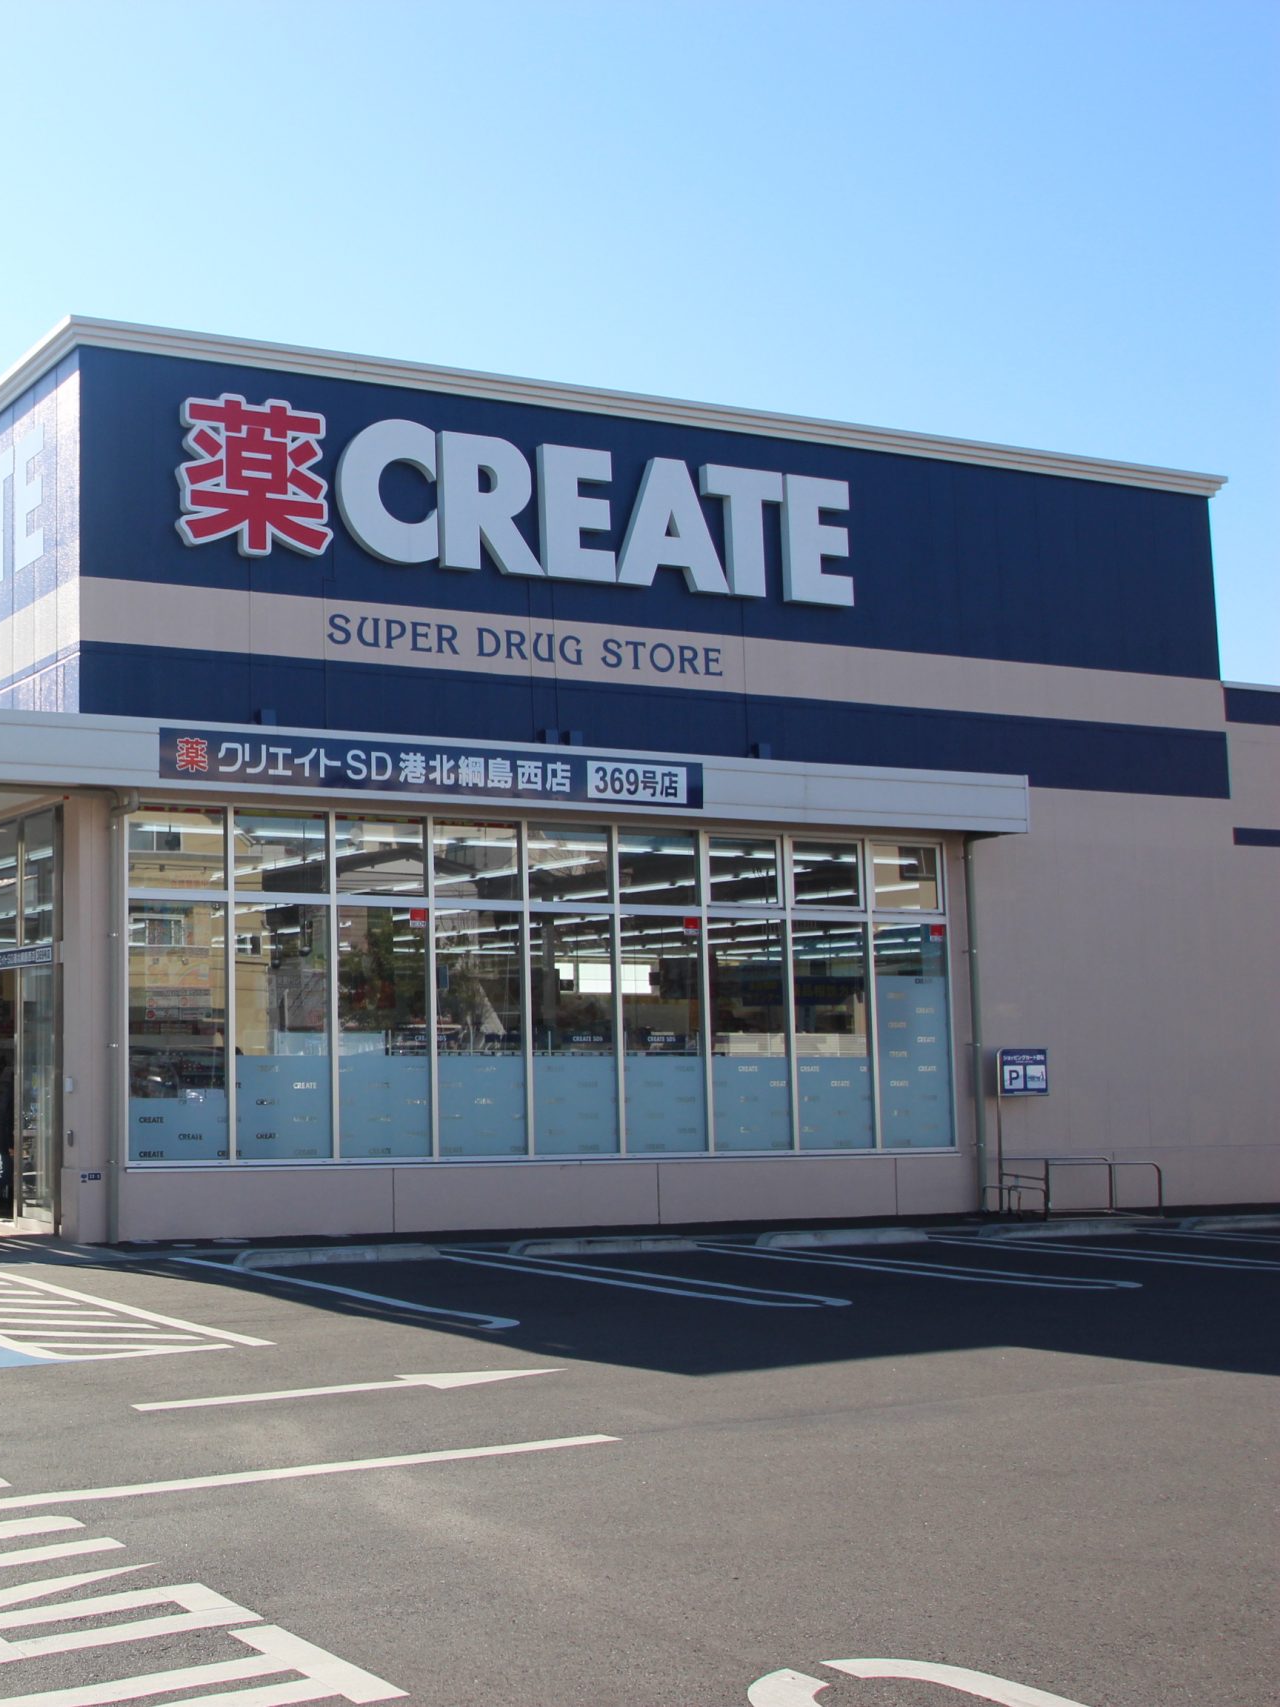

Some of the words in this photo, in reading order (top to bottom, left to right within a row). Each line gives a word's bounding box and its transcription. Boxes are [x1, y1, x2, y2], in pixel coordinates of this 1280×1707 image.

[175, 393, 333, 557] 薬
[335, 419, 854, 607] CREATE
[327, 613, 461, 655] SUPER
[476, 630, 583, 666] DRUG
[601, 639, 723, 678] STORE
[175, 737, 209, 773] 薬
[594, 766, 679, 799] 369号店
[1009, 1070, 1020, 1086] P
[138, 1150, 164, 1158] CREATE
